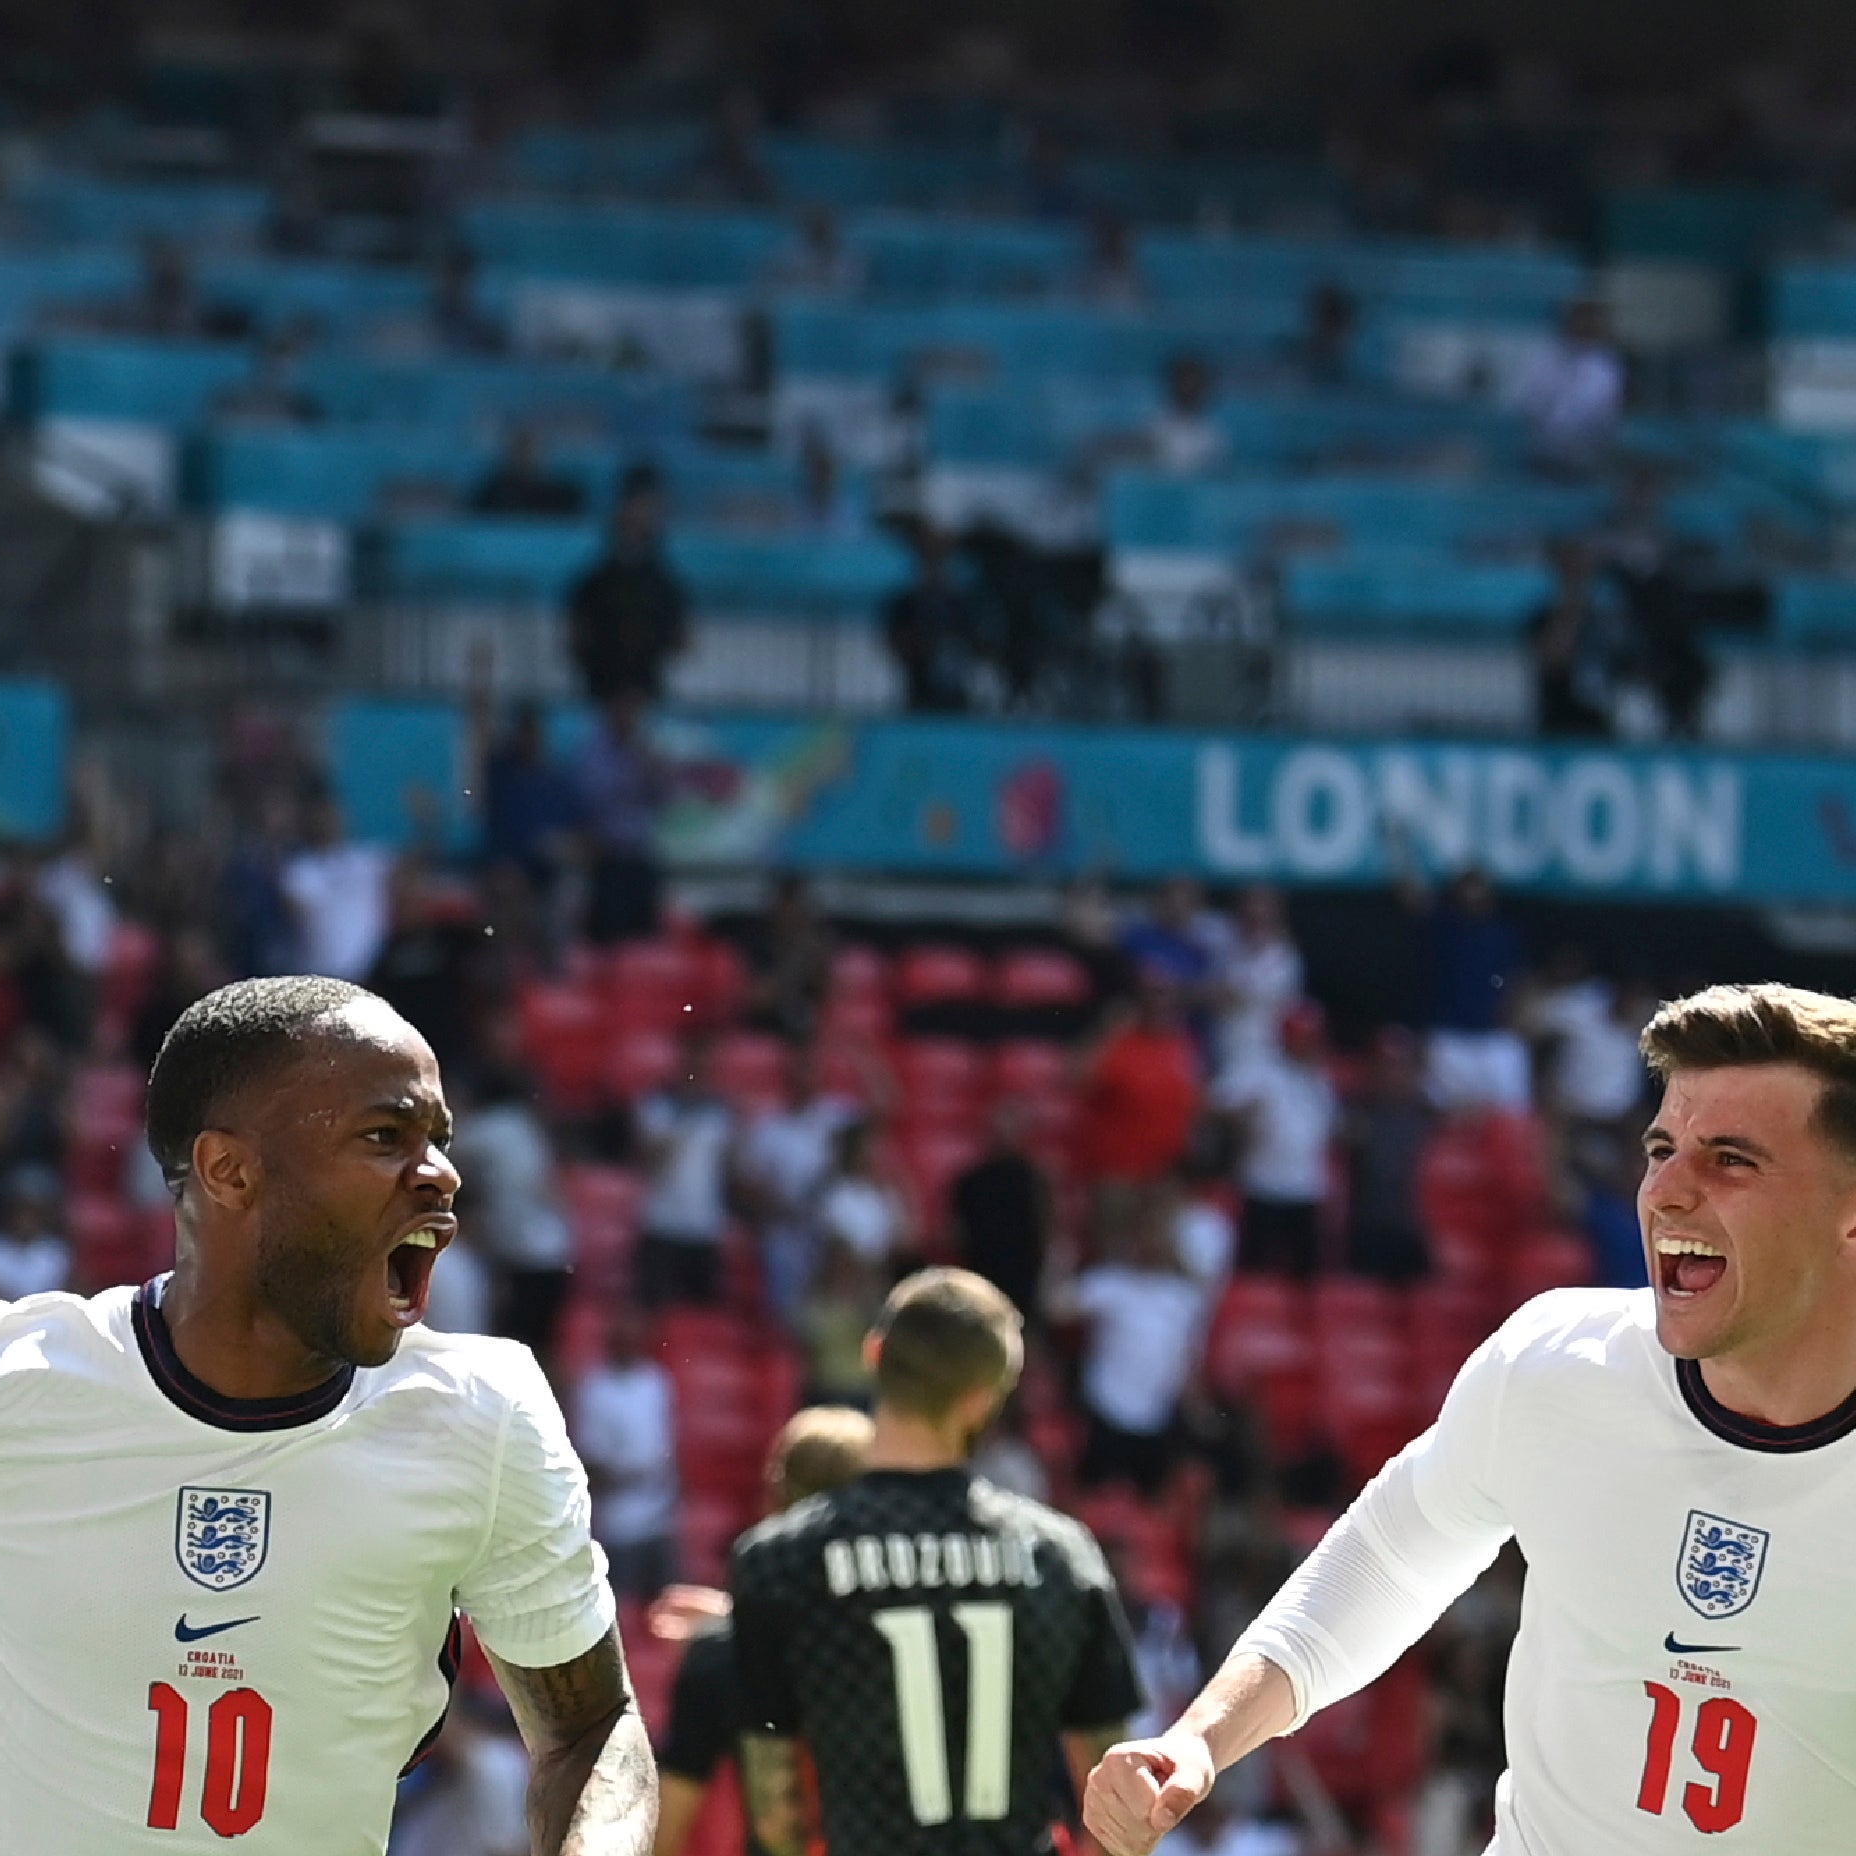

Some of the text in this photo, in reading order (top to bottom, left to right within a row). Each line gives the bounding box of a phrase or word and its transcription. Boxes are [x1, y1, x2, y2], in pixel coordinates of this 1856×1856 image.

[1196, 743, 1744, 890] LONDON
[187, 1651, 235, 1665] CROATIA
[191, 1665, 219, 1679] JUNE
[221, 1668, 245, 1681] 2021
[871, 1602, 1014, 1826] 11
[1680, 1670, 1709, 1685] JUNE
[147, 1680, 273, 1839] 10
[1636, 1680, 1758, 1834] 19
